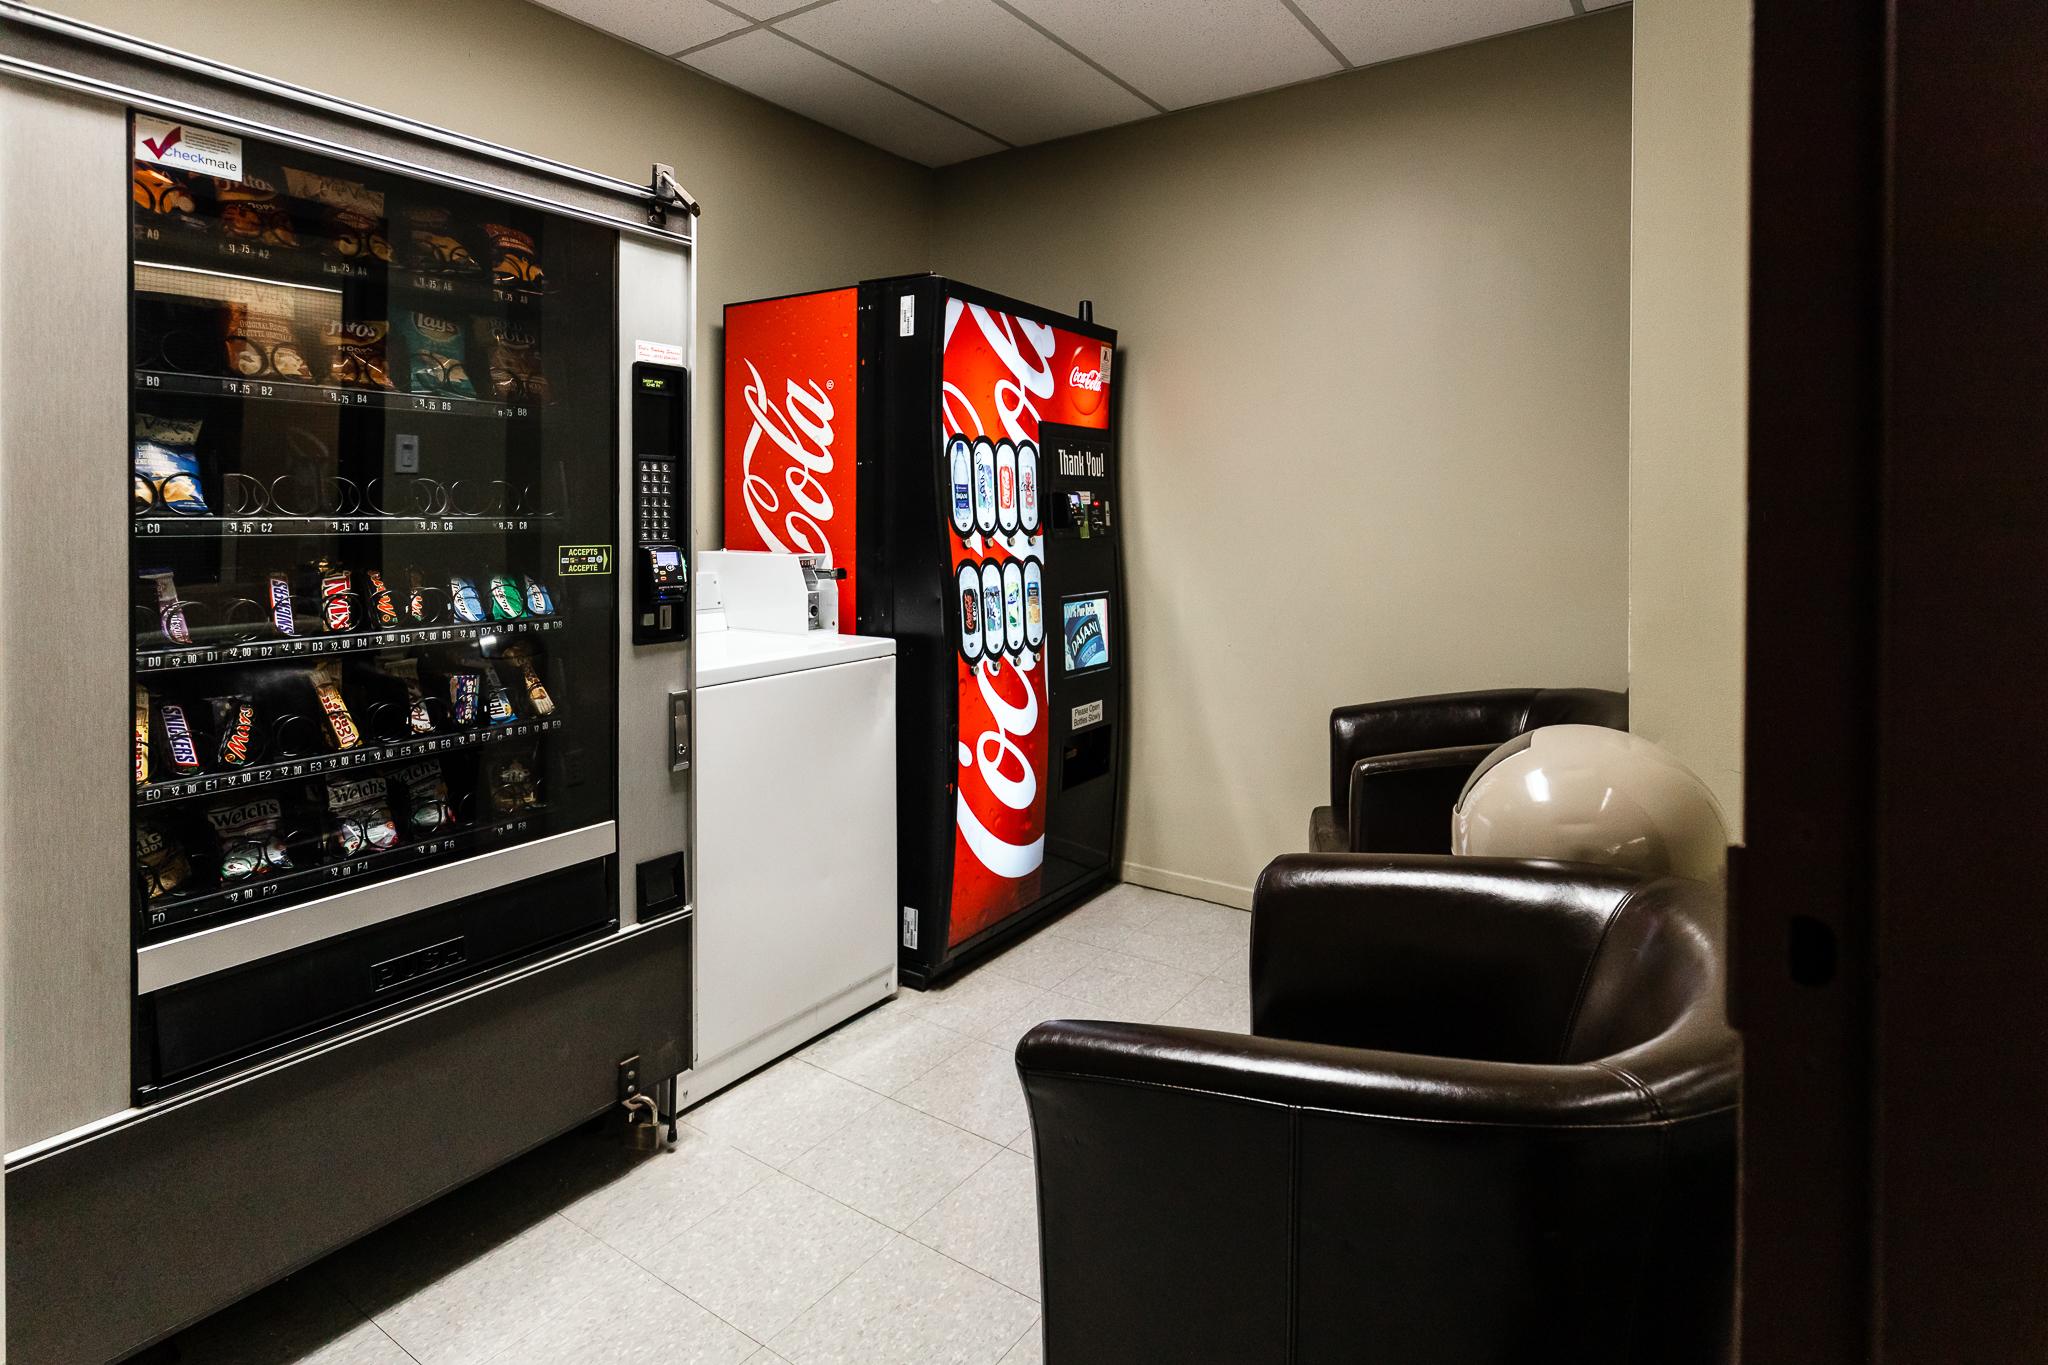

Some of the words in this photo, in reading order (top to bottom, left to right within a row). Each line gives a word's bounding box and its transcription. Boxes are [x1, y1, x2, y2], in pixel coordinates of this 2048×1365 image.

[162, 145, 237, 172] Checkmate
[146, 375, 160, 387] B0
[261, 386, 273, 396] B2
[357, 394, 368, 403] B4
[1058, 449, 1085, 476] Thank
[1086, 451, 1105, 478] You!
[147, 523, 160, 533] C0
[261, 523, 273, 533] C2
[358, 522, 369, 531] C4
[444, 522, 453, 531] C6
[568, 548, 598, 556] ACCEPTS
[452, 582, 468, 614] Trdent
[493, 580, 510, 611] Trdent
[272, 580, 295, 634] SNICKERS
[442, 631, 451, 640] D6
[481, 627, 491, 636] D7
[357, 638, 367, 648] D4
[400, 634, 410, 643] D5
[1071, 620, 1100, 657] DASANI
[261, 647, 273, 657] D2
[312, 642, 323, 652] D3
[148, 657, 161, 667] D0
[207, 652, 218, 661] D1
[1075, 708, 1088, 717] Please
[1089, 704, 1100, 713] Open
[1074, 717, 1087, 726] Bottles
[1088, 712, 1100, 722] Slowly
[163, 706, 195, 763] SNICKERS
[481, 732, 491, 742] E7
[440, 739, 450, 749] E6
[400, 746, 411, 756] E5
[354, 753, 366, 764] E4
[310, 761, 322, 772] E3
[259, 770, 271, 781] E2
[205, 780, 218, 791] E1
[333, 779, 386, 802] Welch's
[146, 789, 160, 801] E0
[212, 801, 278, 827] Welch's
[357, 861, 368, 873] F4
[152, 912, 166, 925] F0
